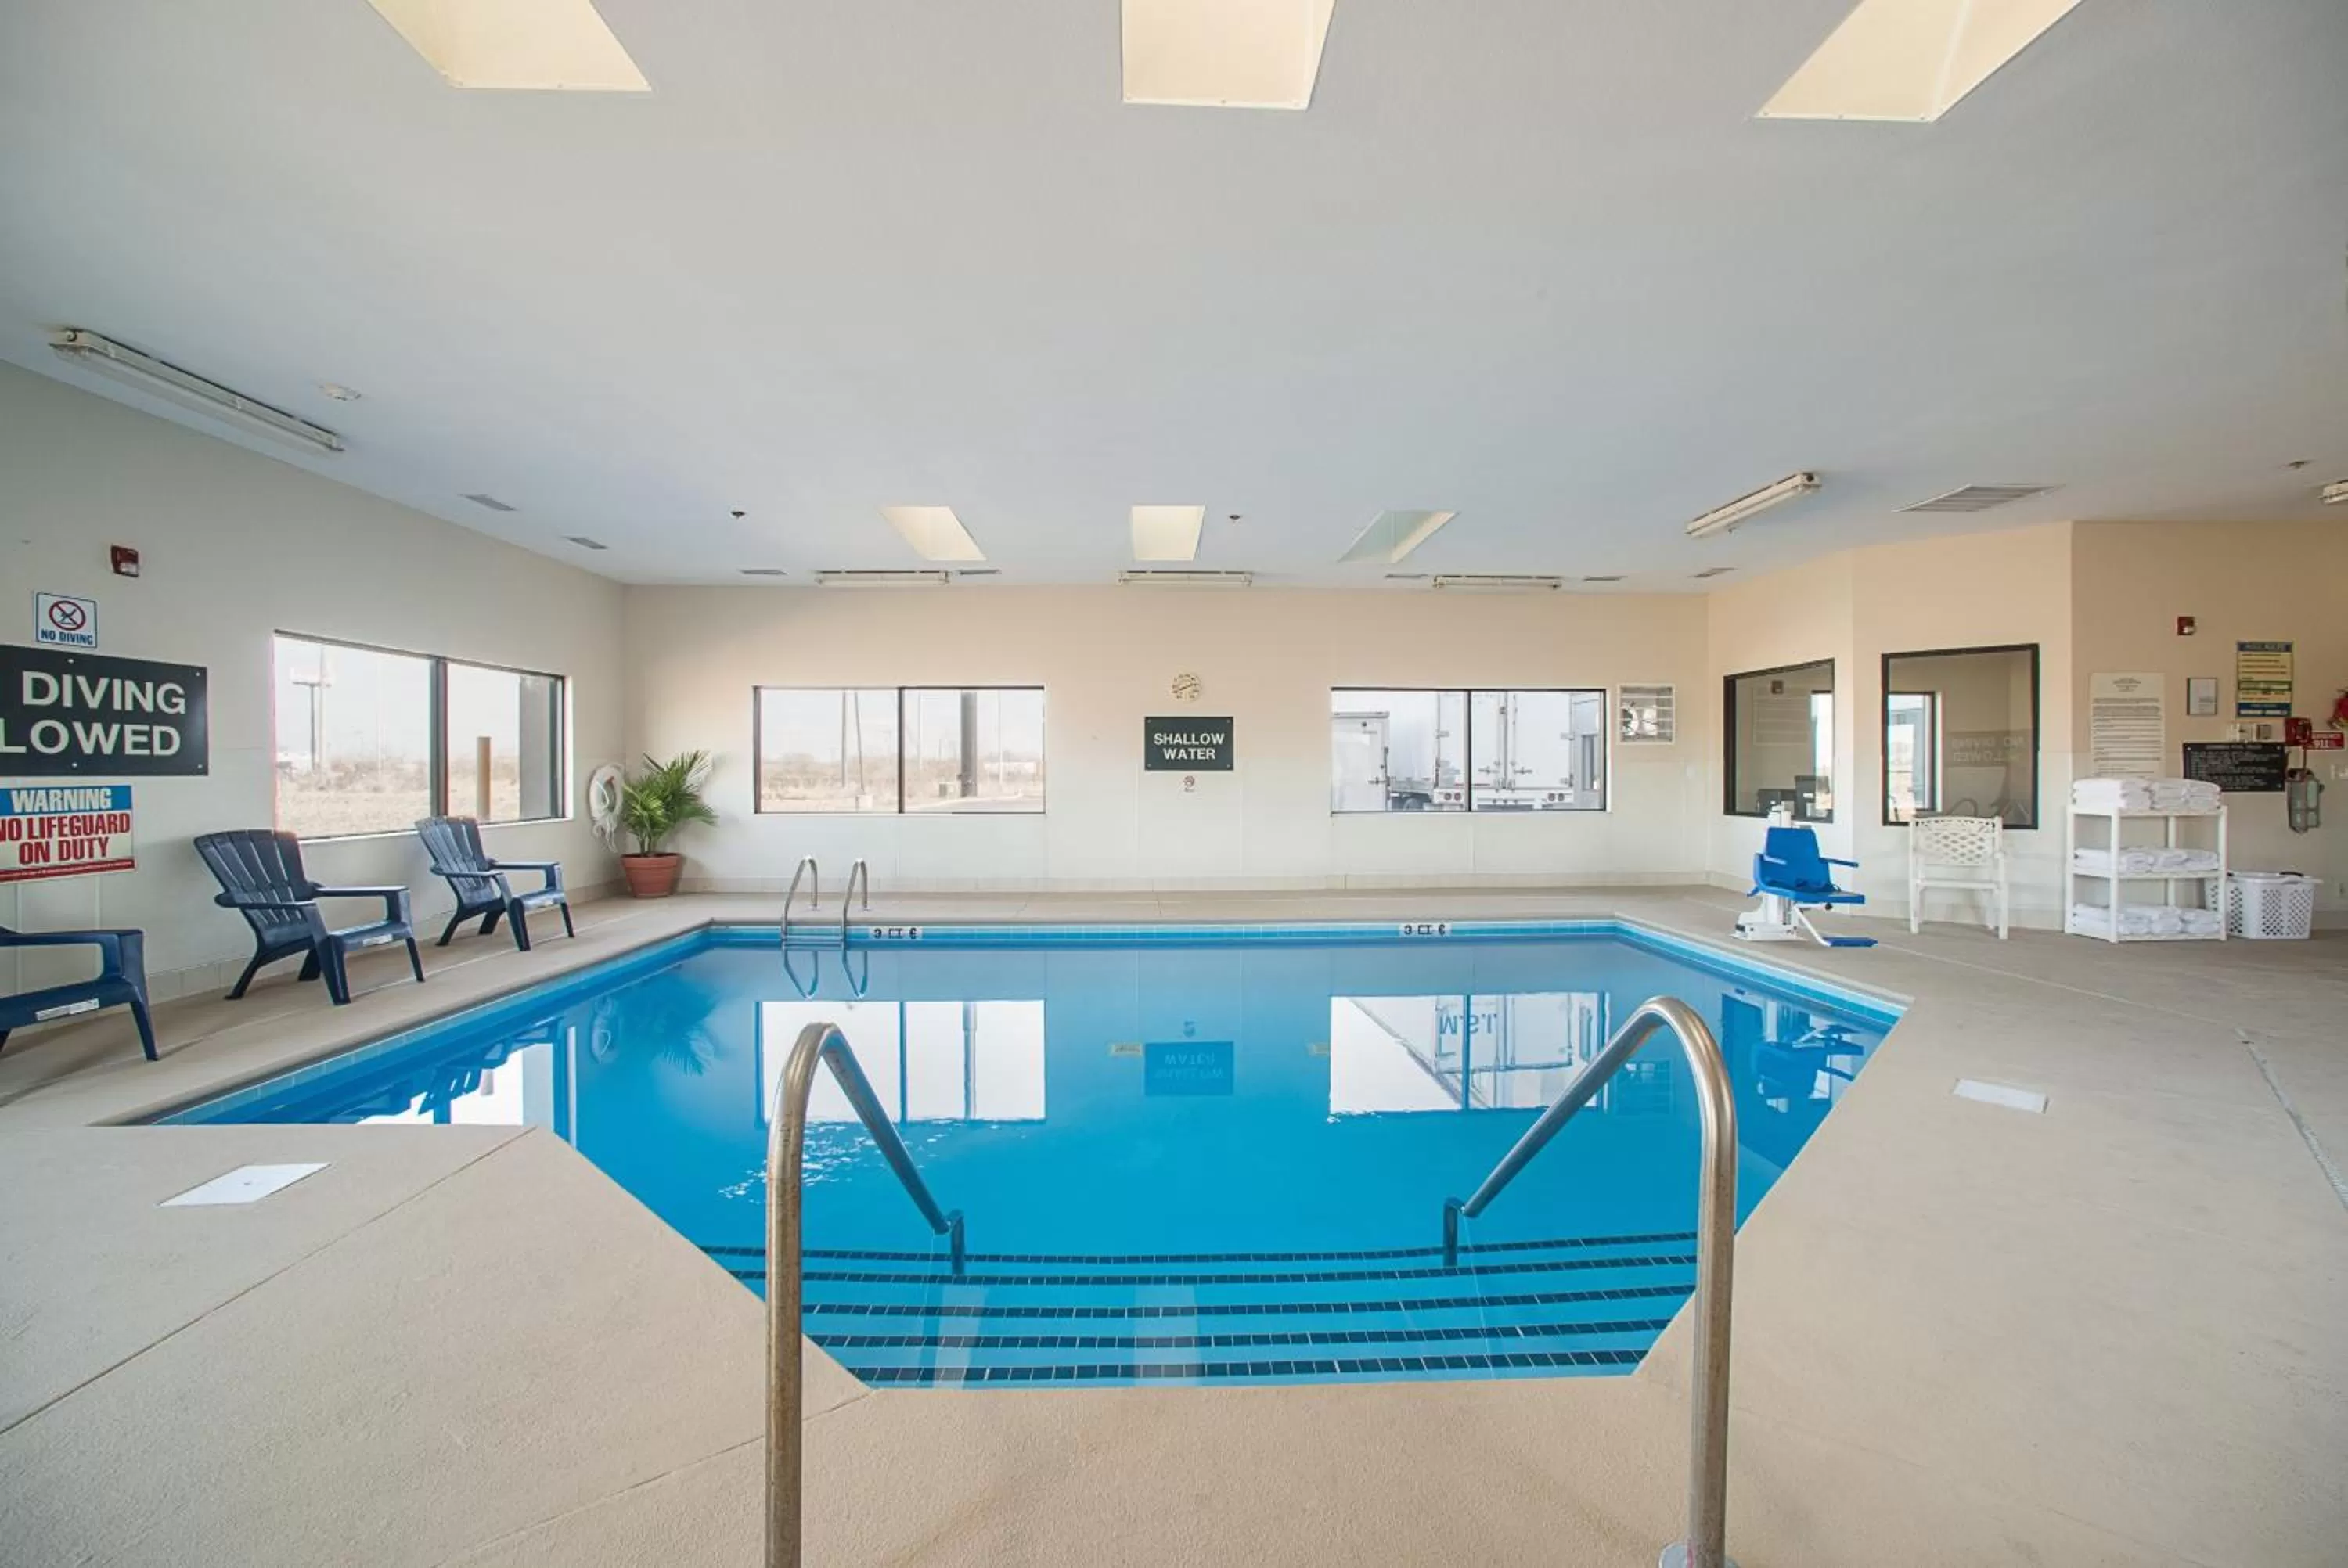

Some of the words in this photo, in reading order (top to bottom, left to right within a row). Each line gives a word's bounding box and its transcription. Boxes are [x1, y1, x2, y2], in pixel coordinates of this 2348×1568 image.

[41, 628, 56, 641] NO
[59, 631, 93, 646] DIVING
[22, 670, 186, 714] DIVING
[0, 717, 181, 757] LOWED
[1154, 733, 1225, 746] SHALLOW
[1163, 748, 1215, 760] WATER
[11, 787, 112, 813] WARNING
[27, 812, 131, 840] LIFEGUARD
[19, 841, 50, 865] ON
[58, 836, 109, 861] DUTY
